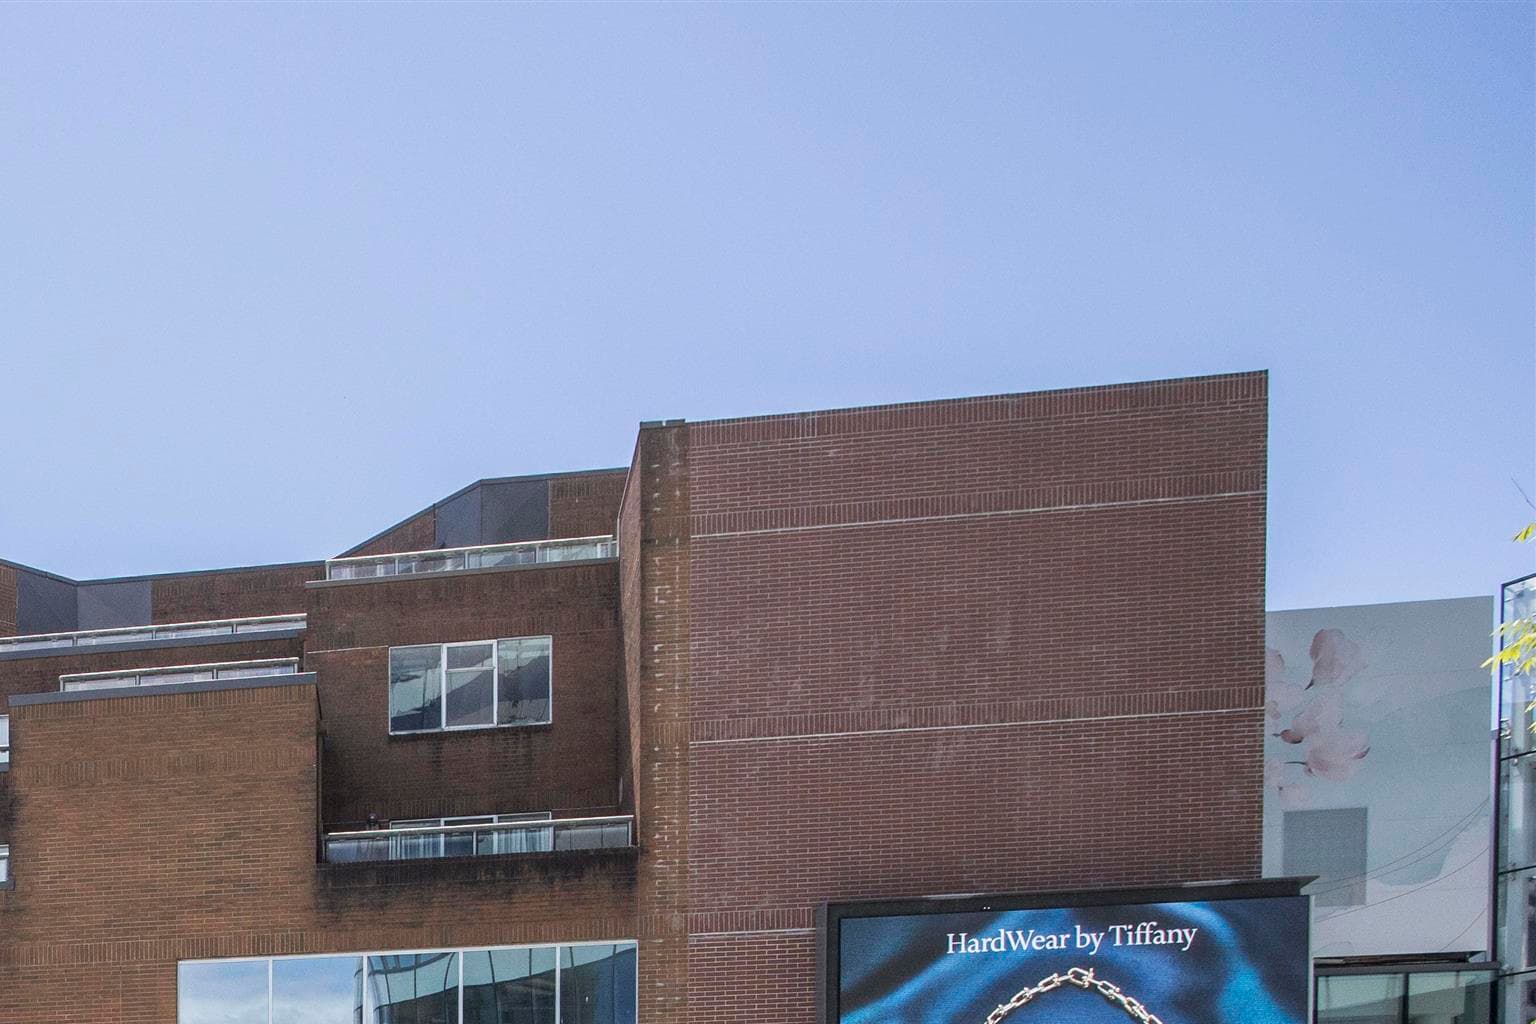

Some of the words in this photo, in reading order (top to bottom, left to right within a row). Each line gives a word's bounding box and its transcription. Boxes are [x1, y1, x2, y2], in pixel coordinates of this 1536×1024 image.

[946, 928, 1069, 954] HardWear
[1074, 925, 1105, 955] by
[1109, 921, 1198, 951] Tiffany
